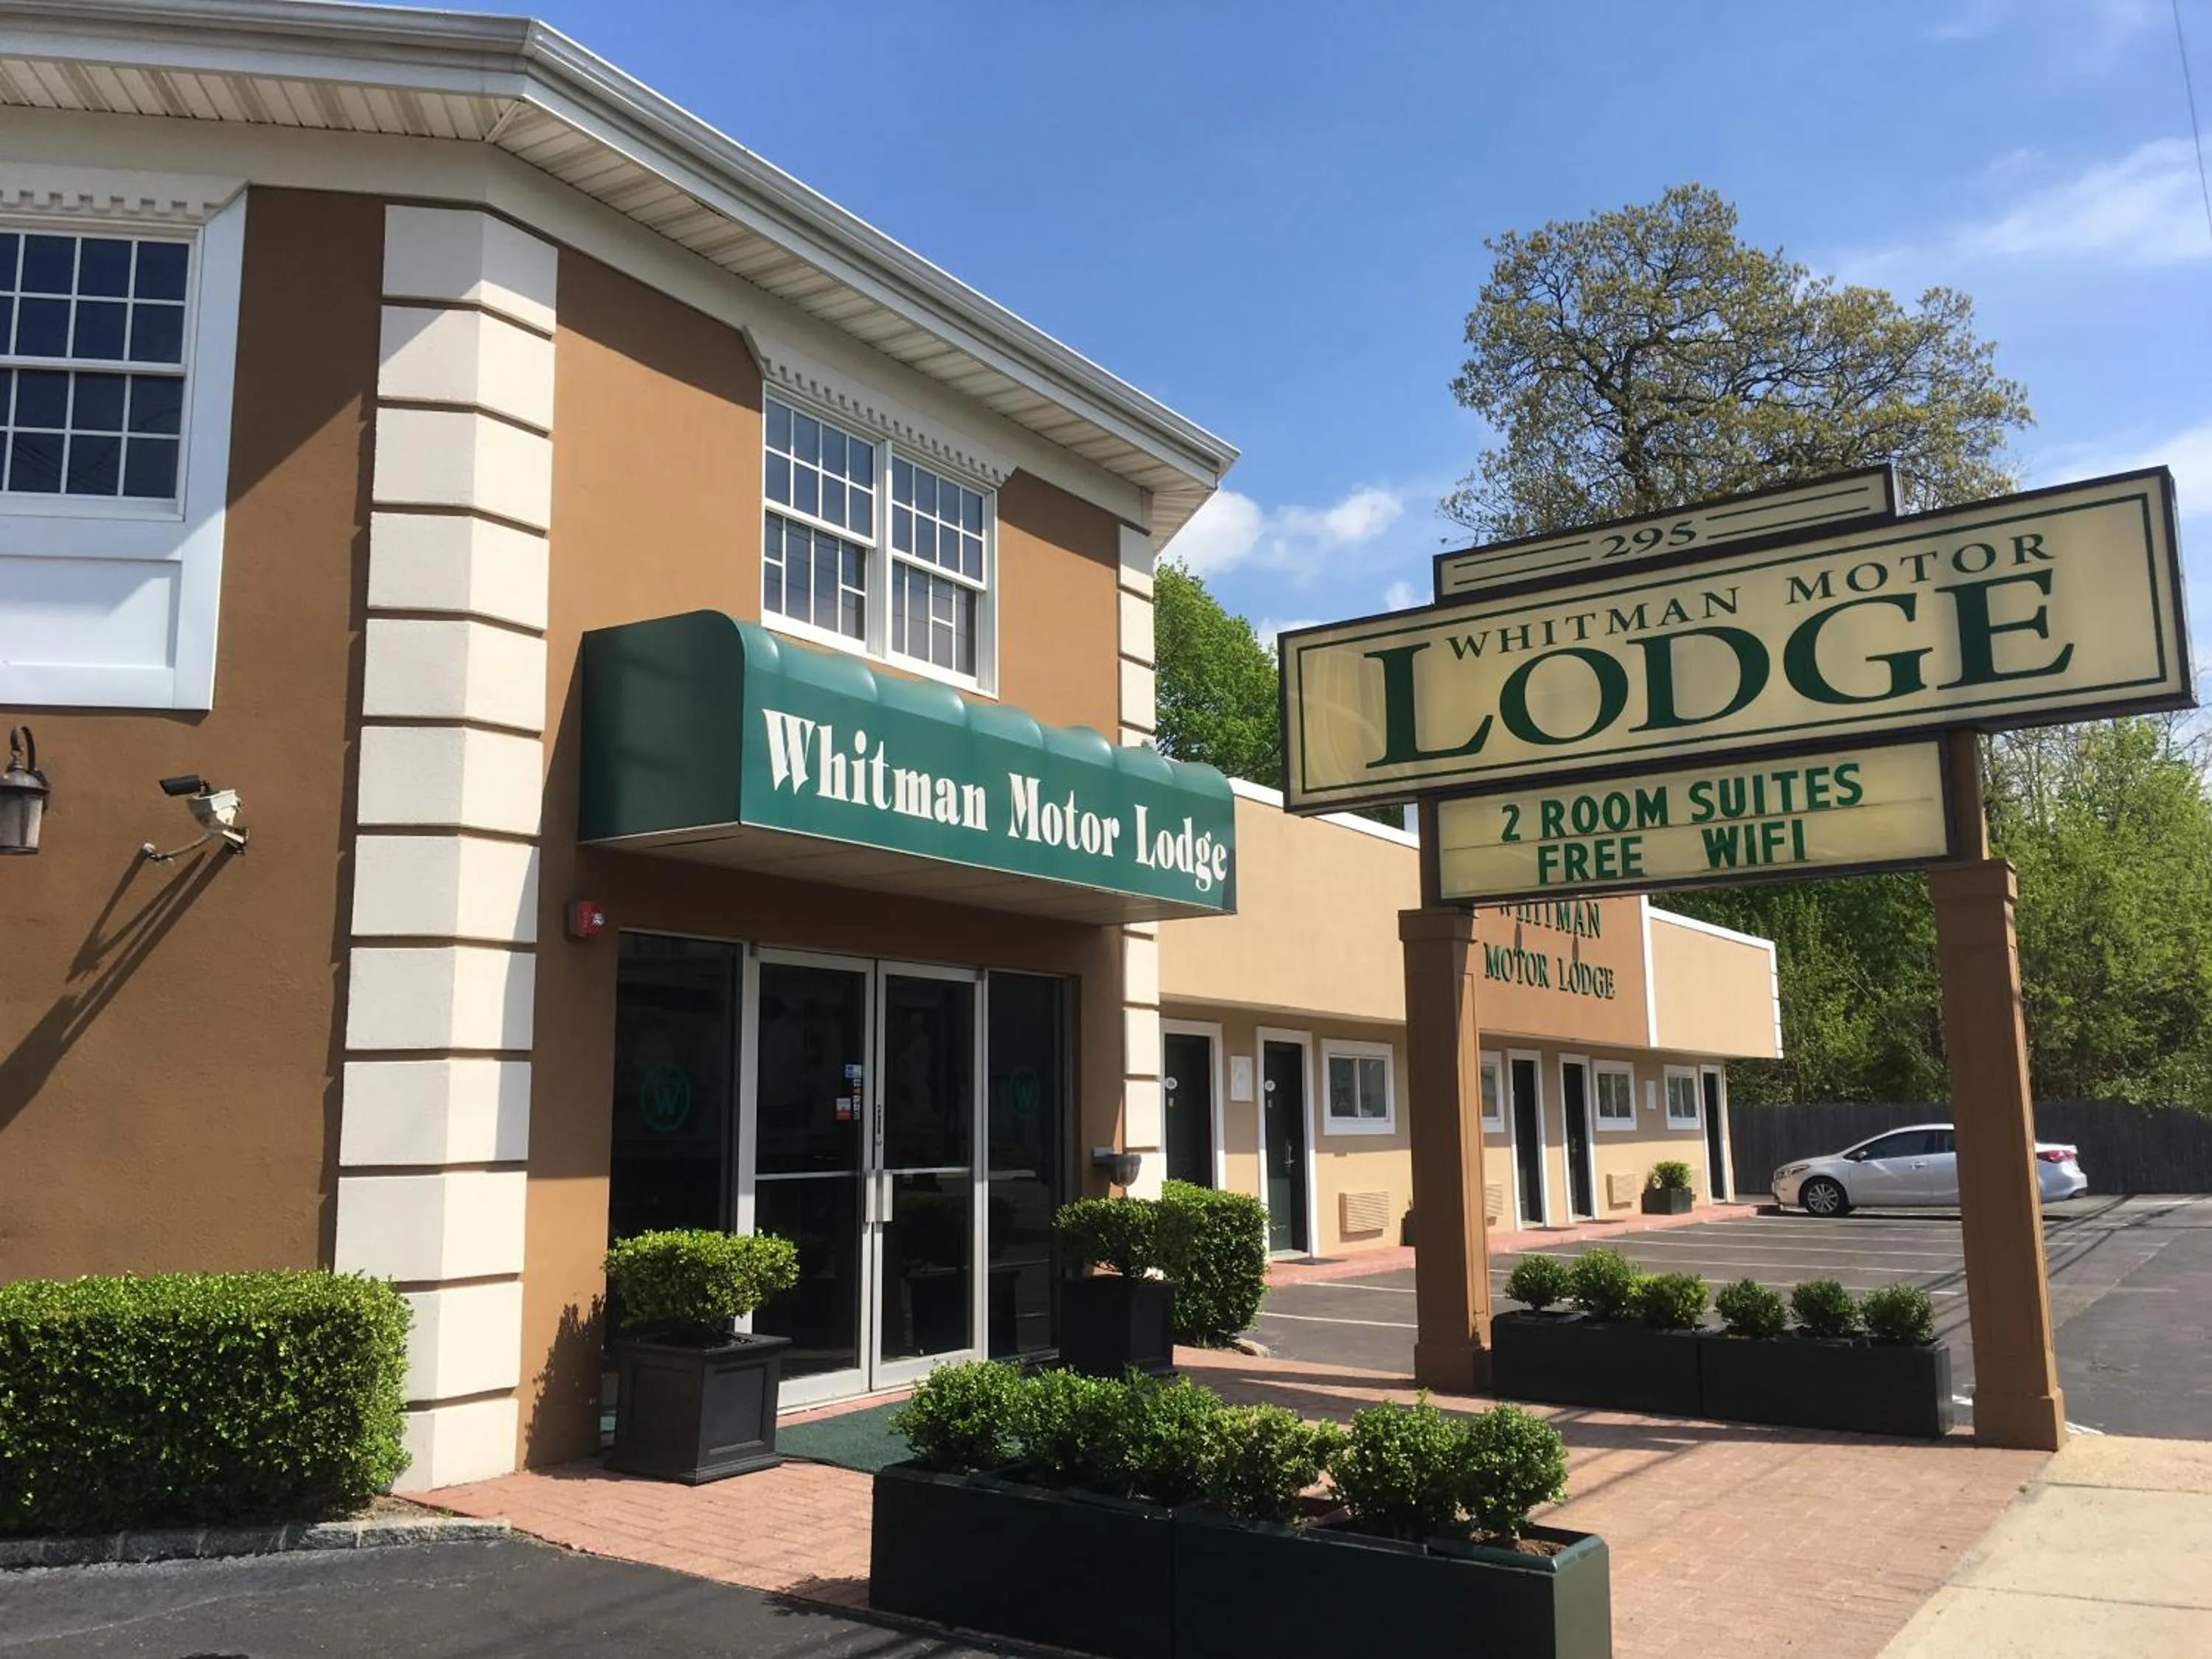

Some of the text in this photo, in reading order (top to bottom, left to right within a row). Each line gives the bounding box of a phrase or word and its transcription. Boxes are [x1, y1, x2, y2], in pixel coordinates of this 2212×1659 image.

[1602, 518, 1697, 560] 295
[1445, 533, 2057, 661] WHITMAN MOTOR
[1365, 568, 2074, 770] LODGE
[762, 709, 1227, 892] Whitman Motor Lodge
[1501, 763, 1864, 842] 2 ROOM SUITES
[1537, 818, 1806, 885] FREE WIFI
[1484, 941, 1617, 1000] MOTOR LODGE
